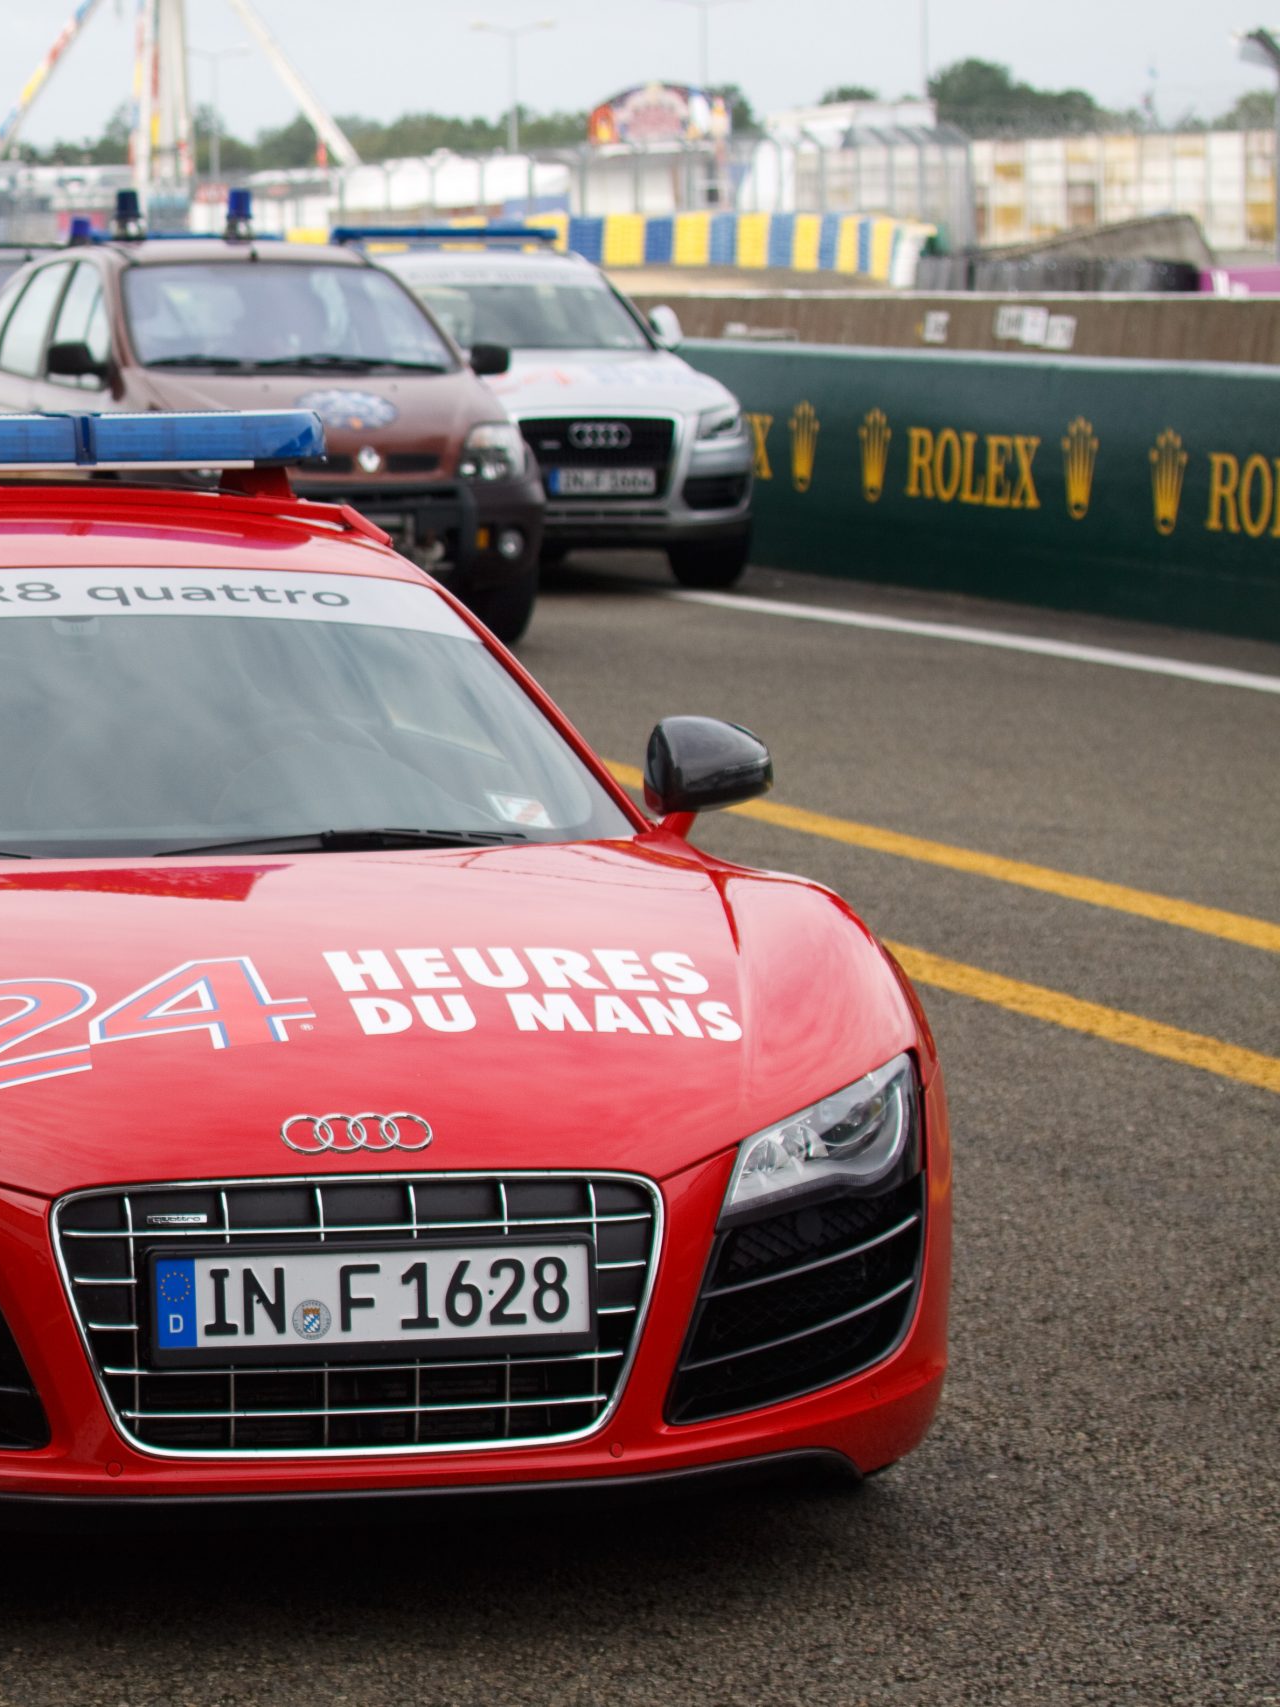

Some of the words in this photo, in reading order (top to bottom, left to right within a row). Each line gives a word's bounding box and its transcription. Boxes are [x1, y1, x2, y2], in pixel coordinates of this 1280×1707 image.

[905, 427, 1041, 509] ROLEX
[86, 582, 352, 610] quattro
[322, 947, 710, 995] HEURES
[348, 995, 478, 1036] DU
[508, 993, 743, 1042] MANS
[169, 1314, 184, 1334] D
[205, 1267, 286, 1336] IN
[340, 1263, 382, 1332] F
[400, 1256, 571, 1330] 1628
